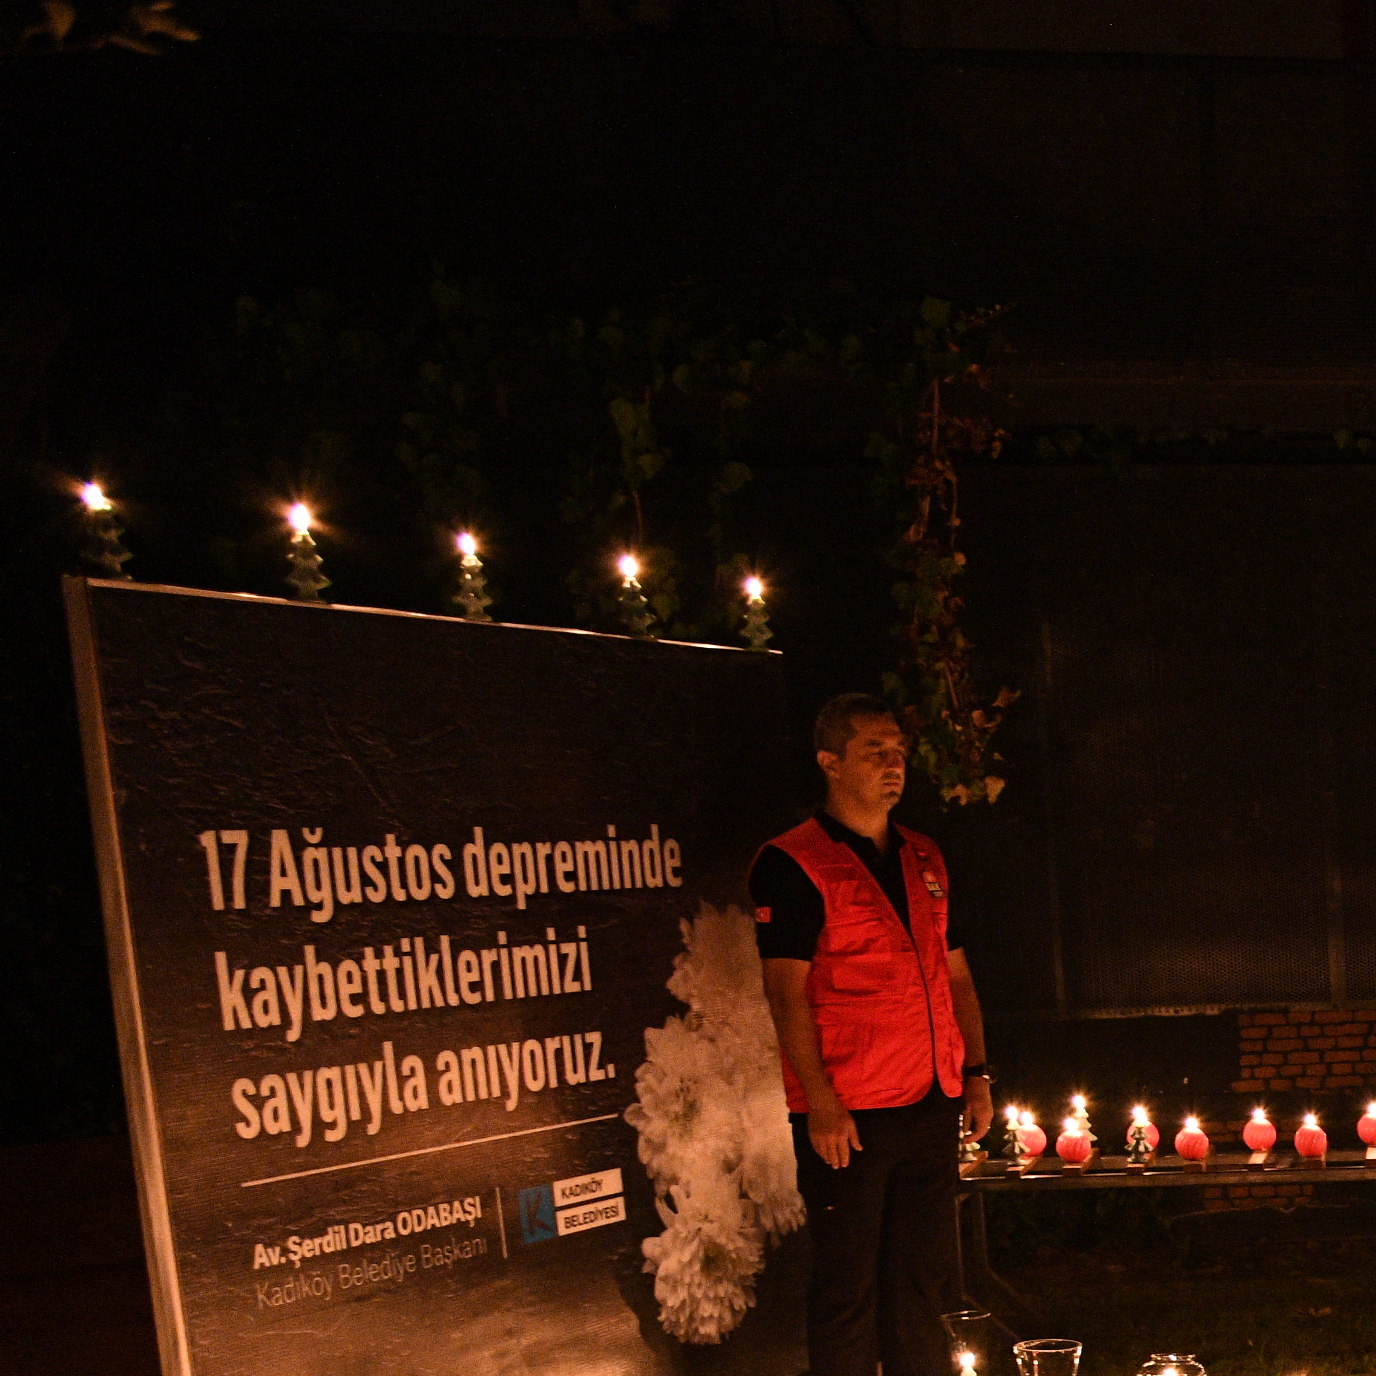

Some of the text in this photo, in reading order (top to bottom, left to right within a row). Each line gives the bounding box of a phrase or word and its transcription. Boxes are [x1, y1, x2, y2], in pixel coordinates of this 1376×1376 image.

[200, 824, 683, 923] 17 Ağustos depreminde
[214, 925, 592, 1042] kaybettiklerimizi
[231, 1031, 616, 1148] saygıyla anıyoruz.
[561, 1177, 604, 1199] KADIKÖY
[253, 1195, 483, 1270] Av. Şerdil Dara ODABAŞI
[255, 1236, 488, 1310] Kadıköy Belediye Başkanı
